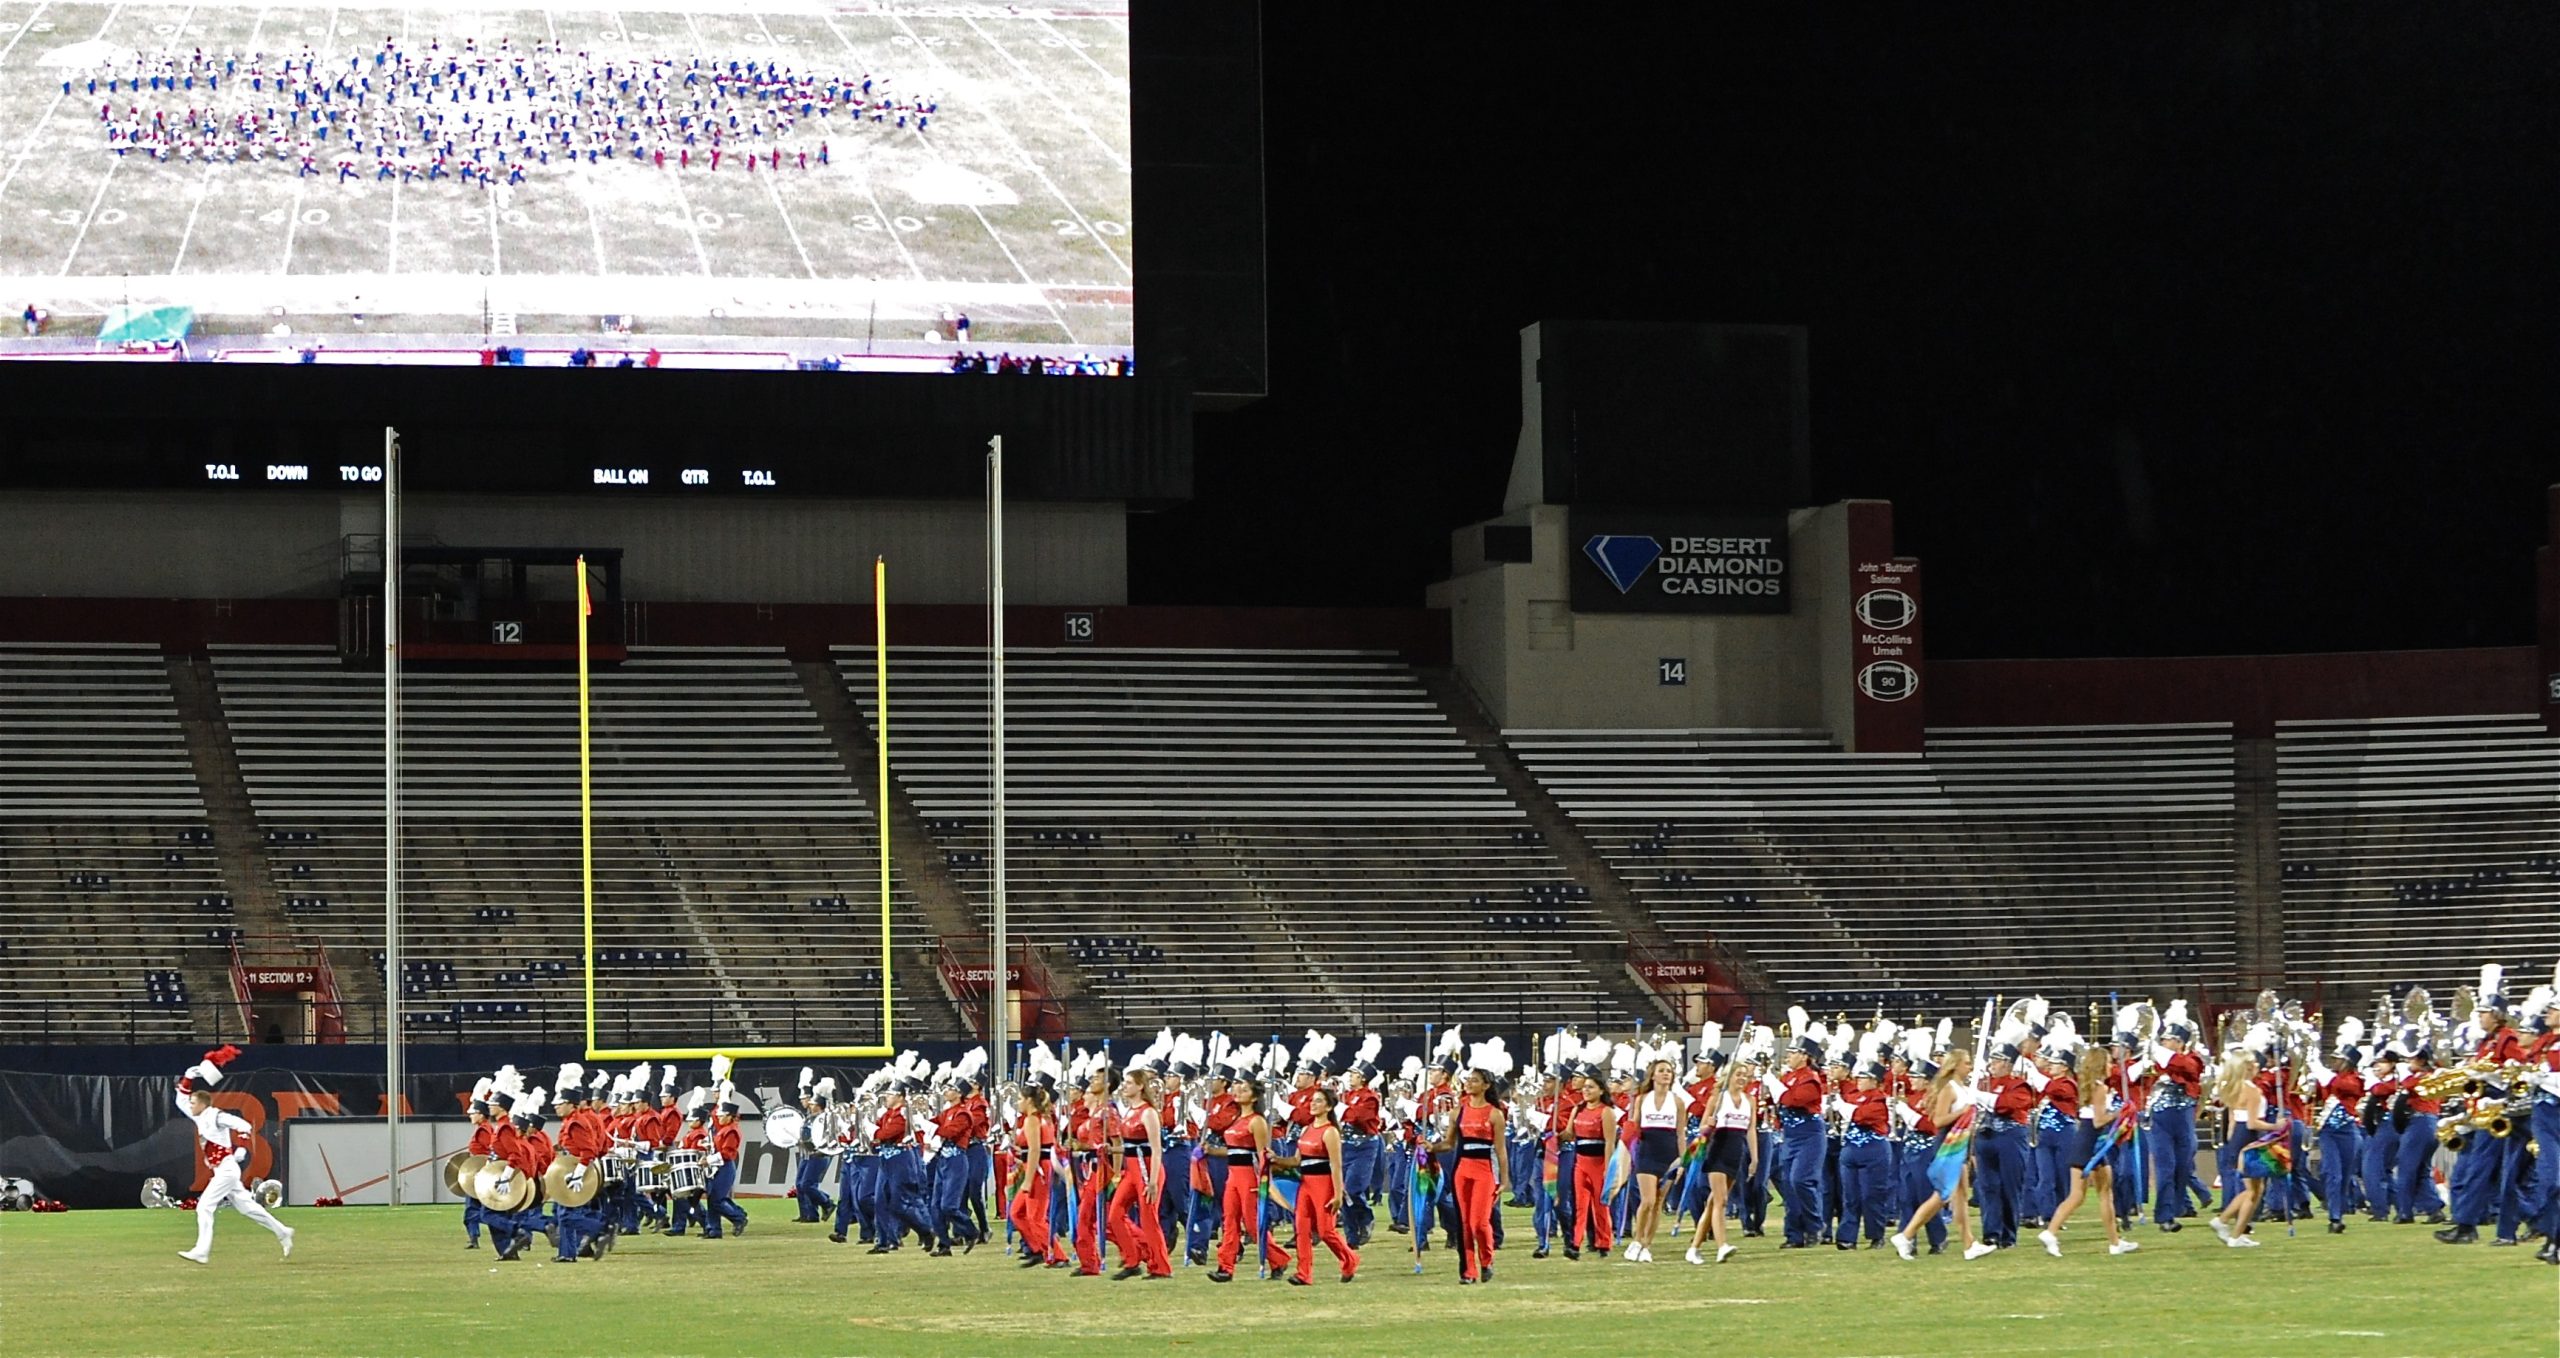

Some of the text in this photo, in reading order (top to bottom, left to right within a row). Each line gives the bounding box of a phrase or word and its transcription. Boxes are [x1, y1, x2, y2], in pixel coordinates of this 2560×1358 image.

[850, 214, 924, 232] 30
[1050, 218, 1127, 237] 20
[266, 465, 308, 480] DOWN
[339, 466, 383, 481] TO GO
[593, 469, 649, 484] BALL ON
[681, 469, 709, 485] QTR
[1670, 537, 1772, 555] DESERT
[1658, 557, 1784, 575] DIAMOND
[1858, 562, 1879, 572] John
[1662, 577, 1780, 596] CASINOS
[1870, 574, 1902, 584] Salmon
[494, 622, 520, 642] 12
[1066, 617, 1092, 637] 13
[1862, 634, 1913, 645] McCollins
[1872, 646, 1903, 656] Umeh
[1660, 661, 1685, 682] 14
[1881, 677, 1896, 687] 90
[248, 972, 305, 984] 11 SECTION 12
[966, 970, 998, 981] SECTIO
[1656, 966, 1687, 977] SECTION
[1688, 966, 1697, 976] 14
